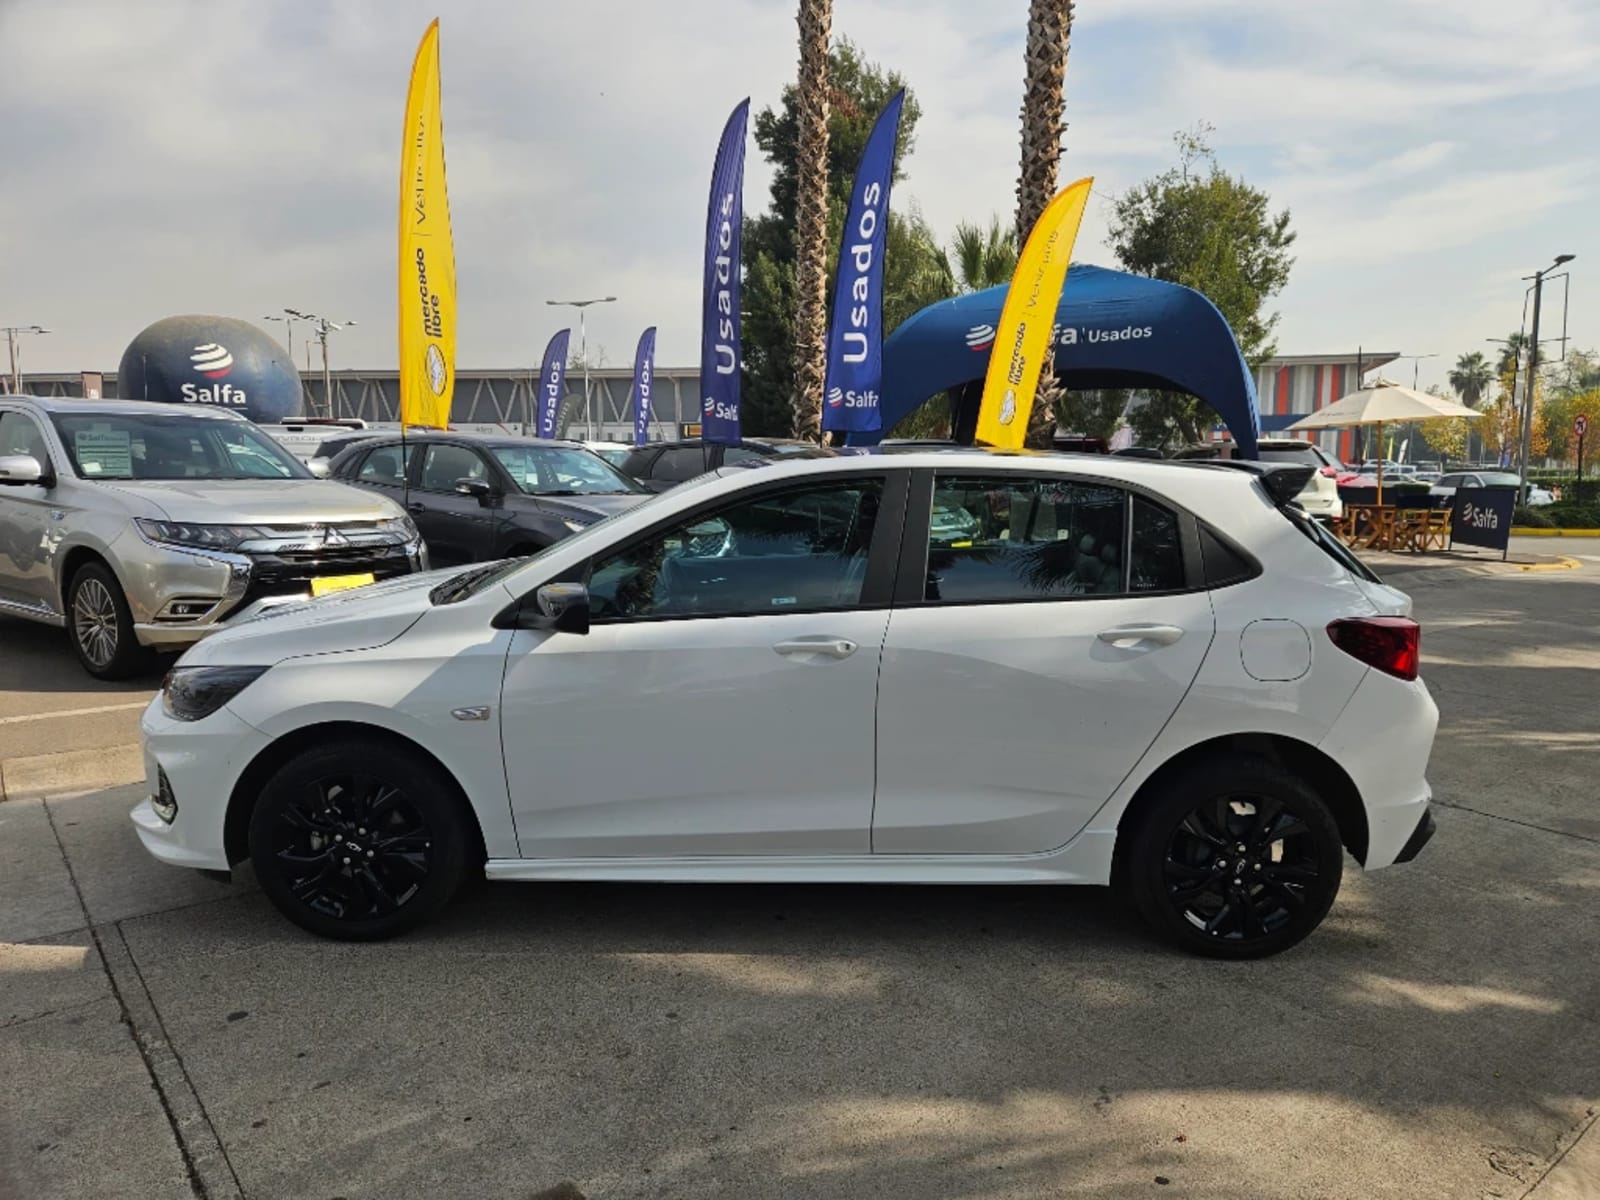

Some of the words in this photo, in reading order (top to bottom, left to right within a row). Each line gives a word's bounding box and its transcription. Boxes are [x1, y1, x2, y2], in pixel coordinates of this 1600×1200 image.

[416, 247, 432, 336] mercado
[715, 192, 735, 375] Usados
[843, 182, 880, 362] Usados
[430, 294, 442, 338] libre
[1088, 326, 1153, 343] Usados
[180, 382, 247, 404] Salfa
[544, 361, 560, 432] Usados
[1472, 507, 1498, 529] Salfa
